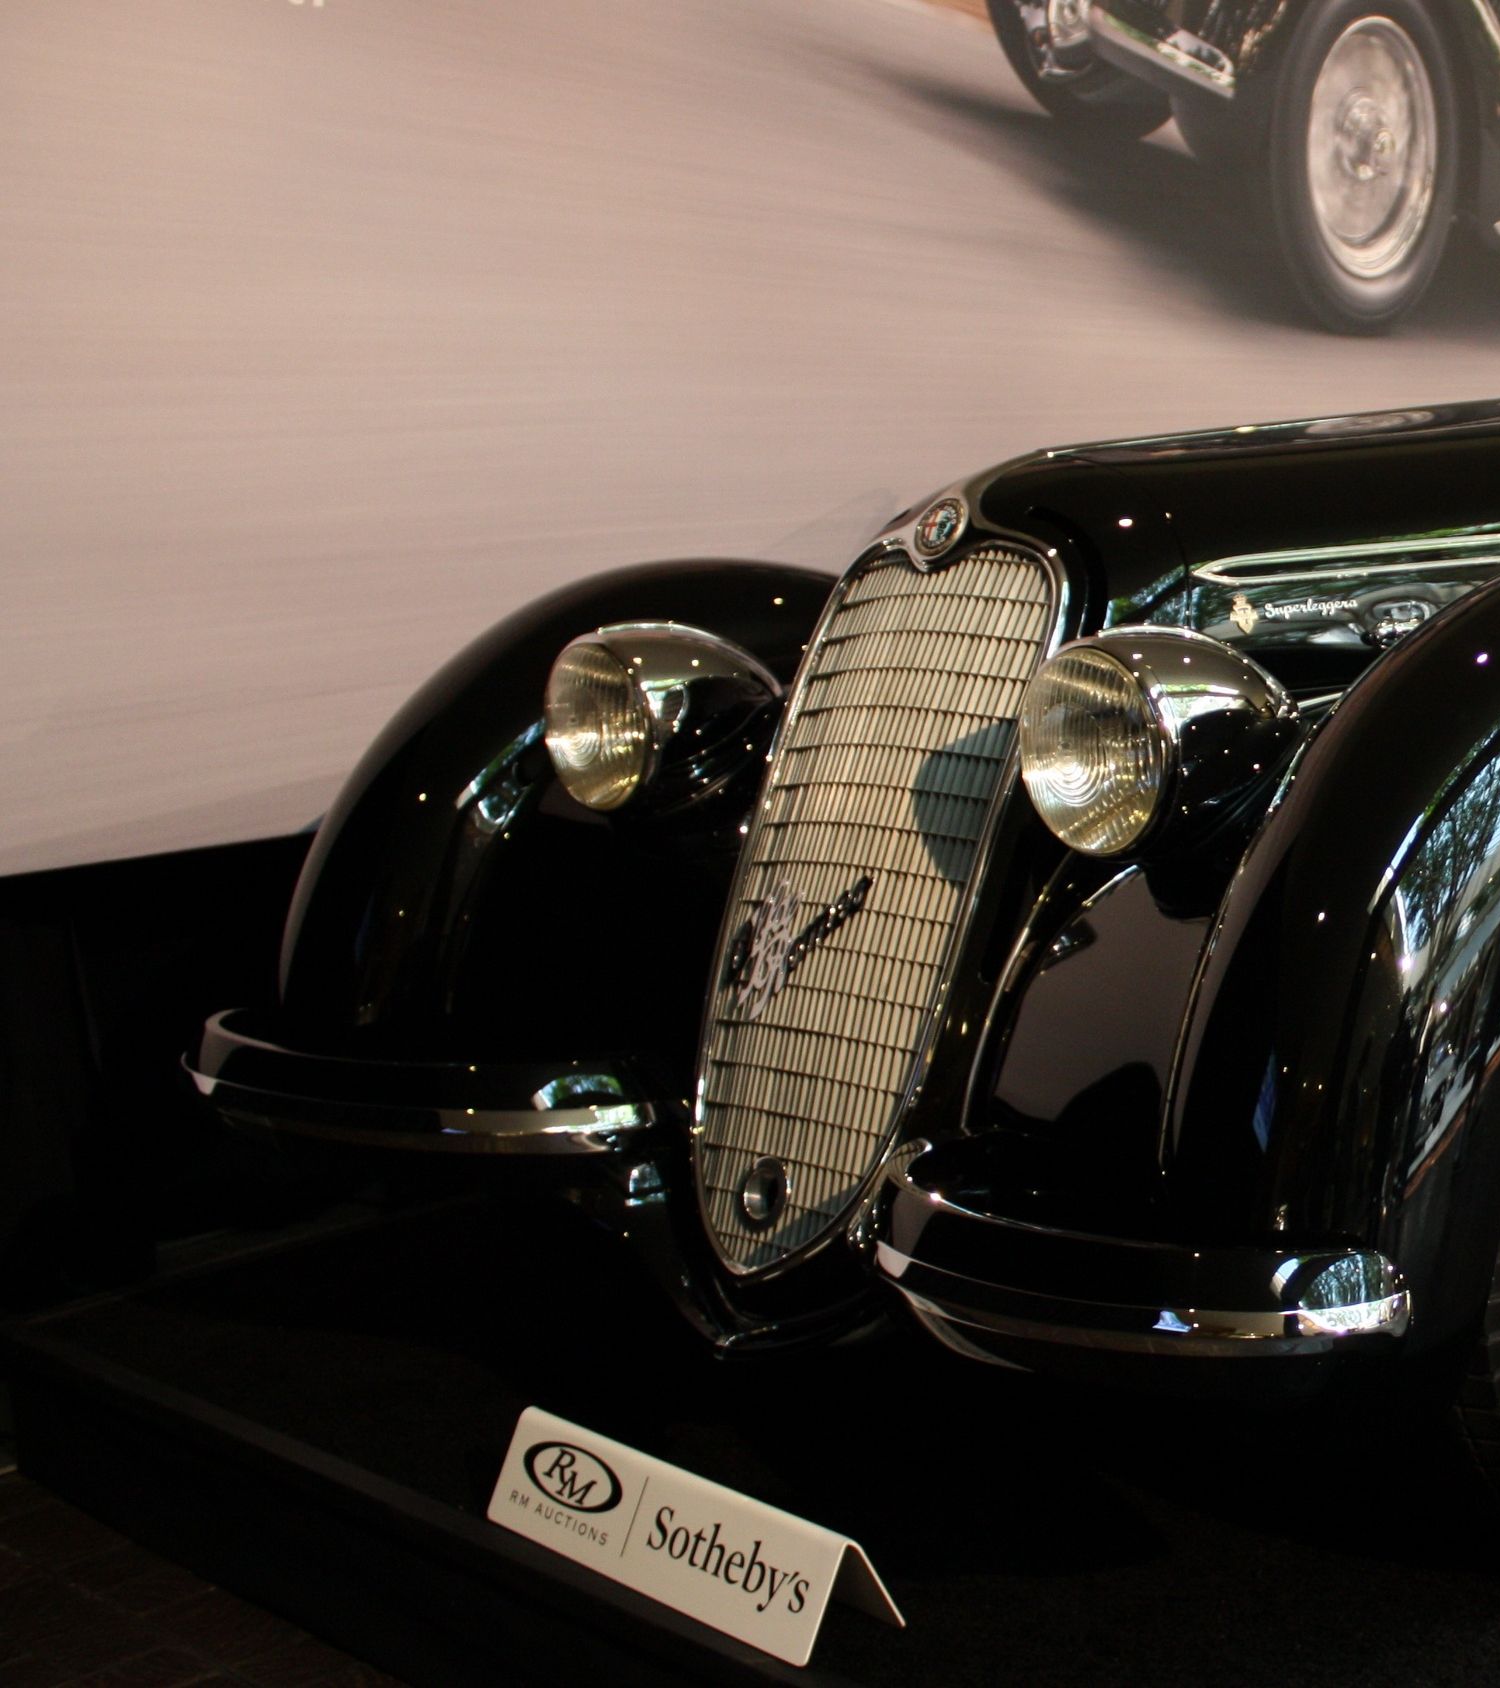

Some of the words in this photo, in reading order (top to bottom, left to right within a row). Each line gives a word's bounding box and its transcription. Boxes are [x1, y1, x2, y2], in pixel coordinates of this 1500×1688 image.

[1265, 598, 1358, 619] Superleggera
[543, 1448, 597, 1505] RM
[509, 1489, 530, 1507] RM
[535, 1504, 609, 1546] AUCTIONS
[646, 1506, 810, 1613] Sotheby's
